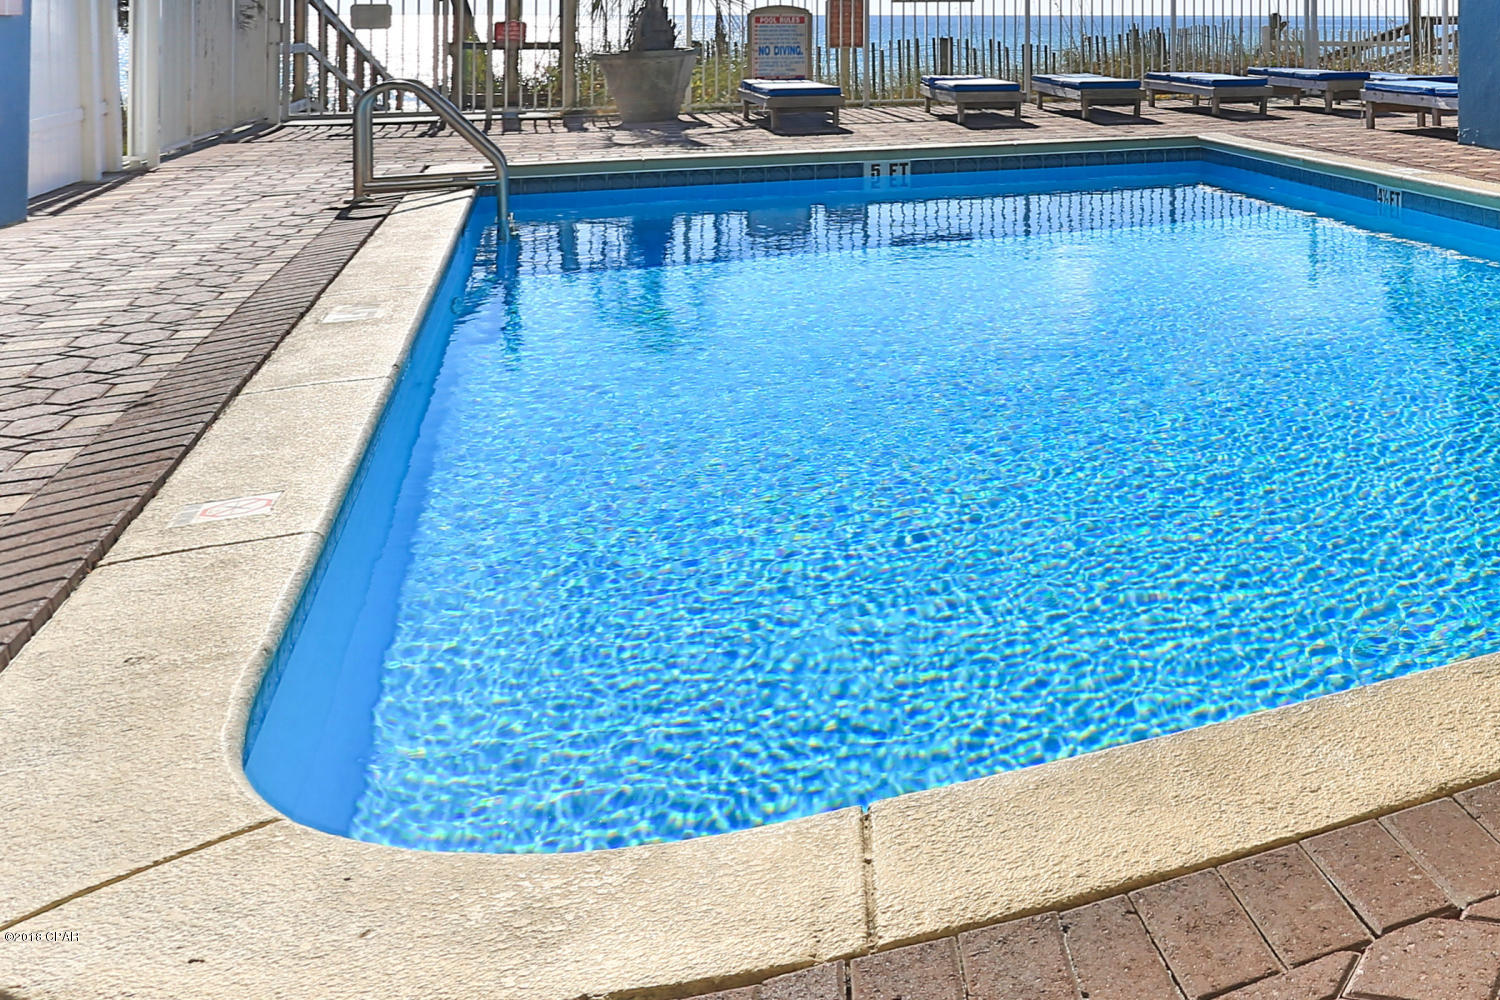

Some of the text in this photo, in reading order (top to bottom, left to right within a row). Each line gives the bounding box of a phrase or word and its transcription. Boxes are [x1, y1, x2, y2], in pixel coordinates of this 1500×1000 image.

[758, 45, 770, 56] NO
[871, 162, 908, 176] 5 FT
[1390, 190, 1400, 206] FT
